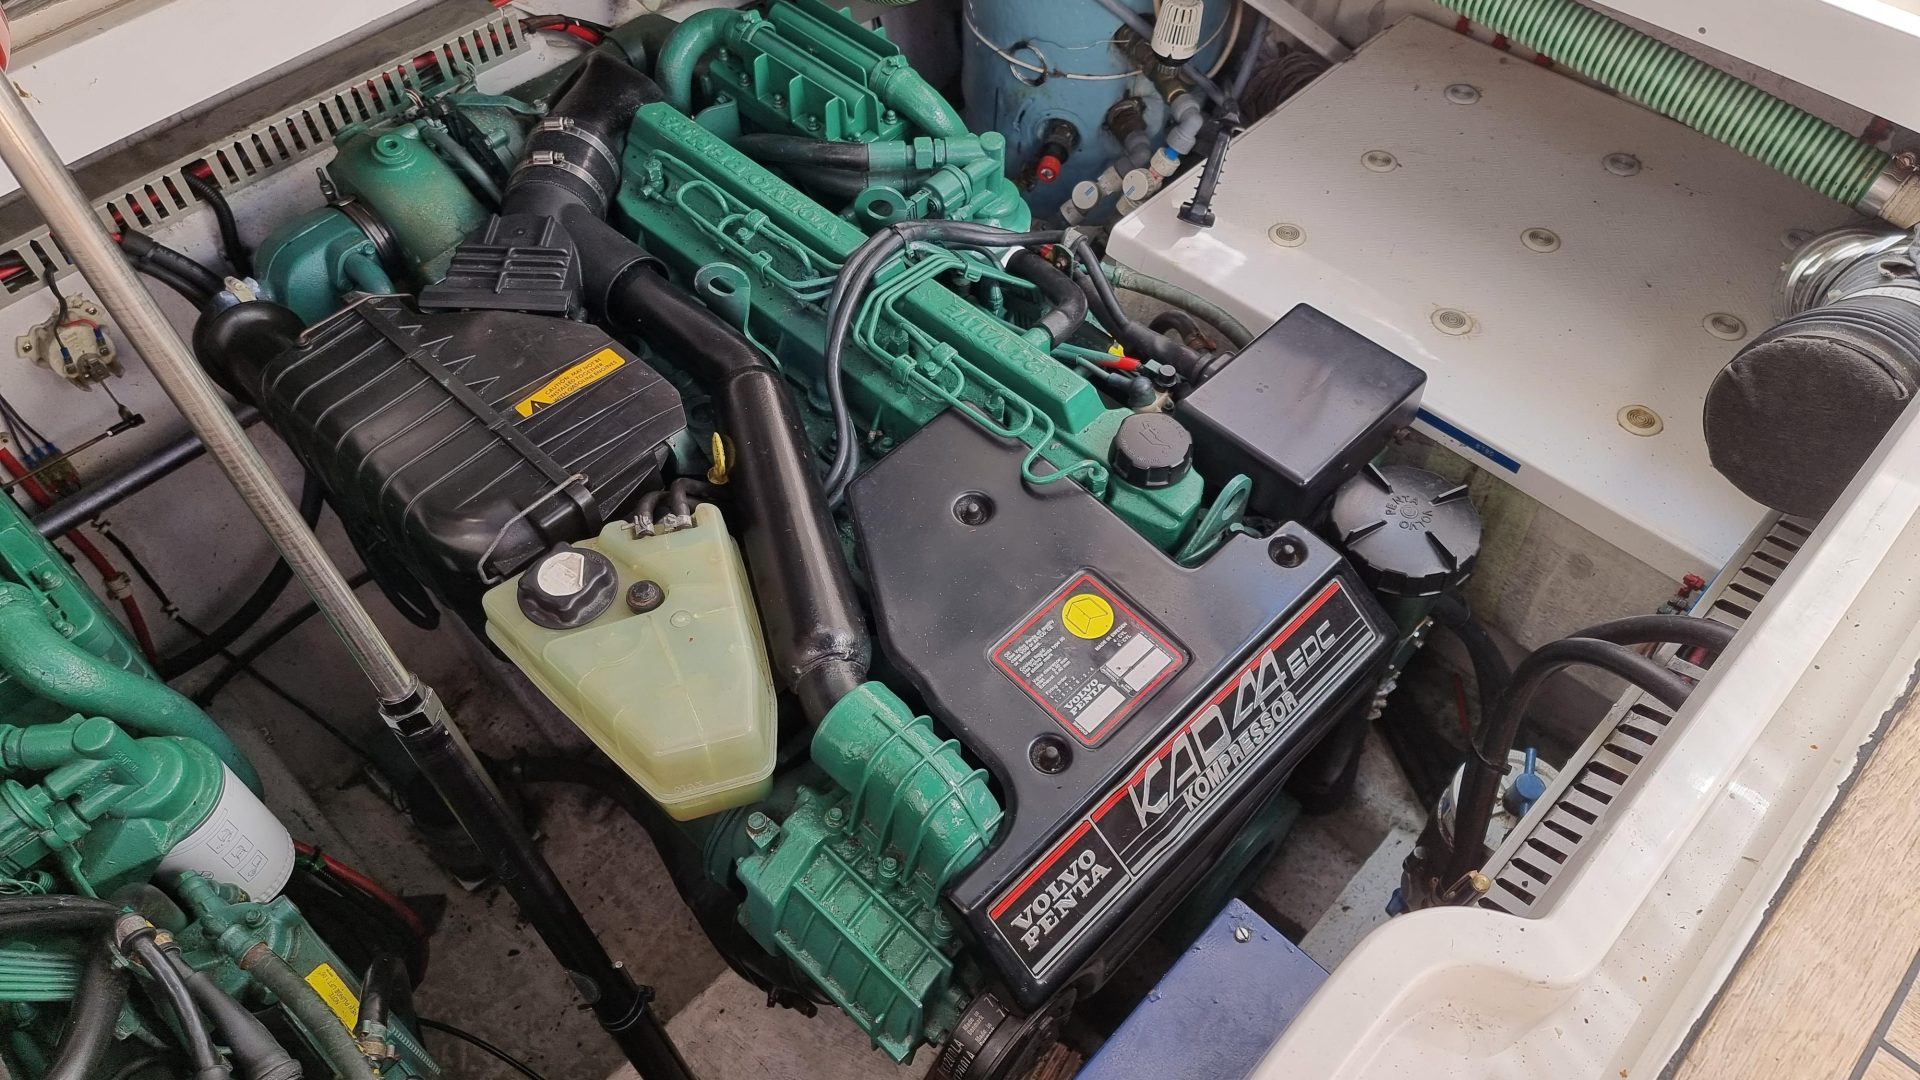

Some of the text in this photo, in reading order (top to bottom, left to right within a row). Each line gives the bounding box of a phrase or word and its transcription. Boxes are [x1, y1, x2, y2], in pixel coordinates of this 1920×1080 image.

[1385, 495, 1432, 530] VOLVO PENTA
[1094, 638, 1108, 651] MADE
[1110, 621, 1128, 637] SWEDEN
[1063, 677, 1099, 711] VOLVO
[1069, 681, 1107, 715] PENTA
[1128, 704, 1233, 828] KAD
[1282, 619, 1336, 680] EDC
[1182, 688, 1299, 812] KOMPRESSOR
[1011, 848, 1098, 934] VOLVO
[1020, 863, 1112, 951] PENTA
[962, 1018, 975, 1031] Made
[967, 1016, 984, 1035] Denmark
[975, 1030, 987, 1041] Made
